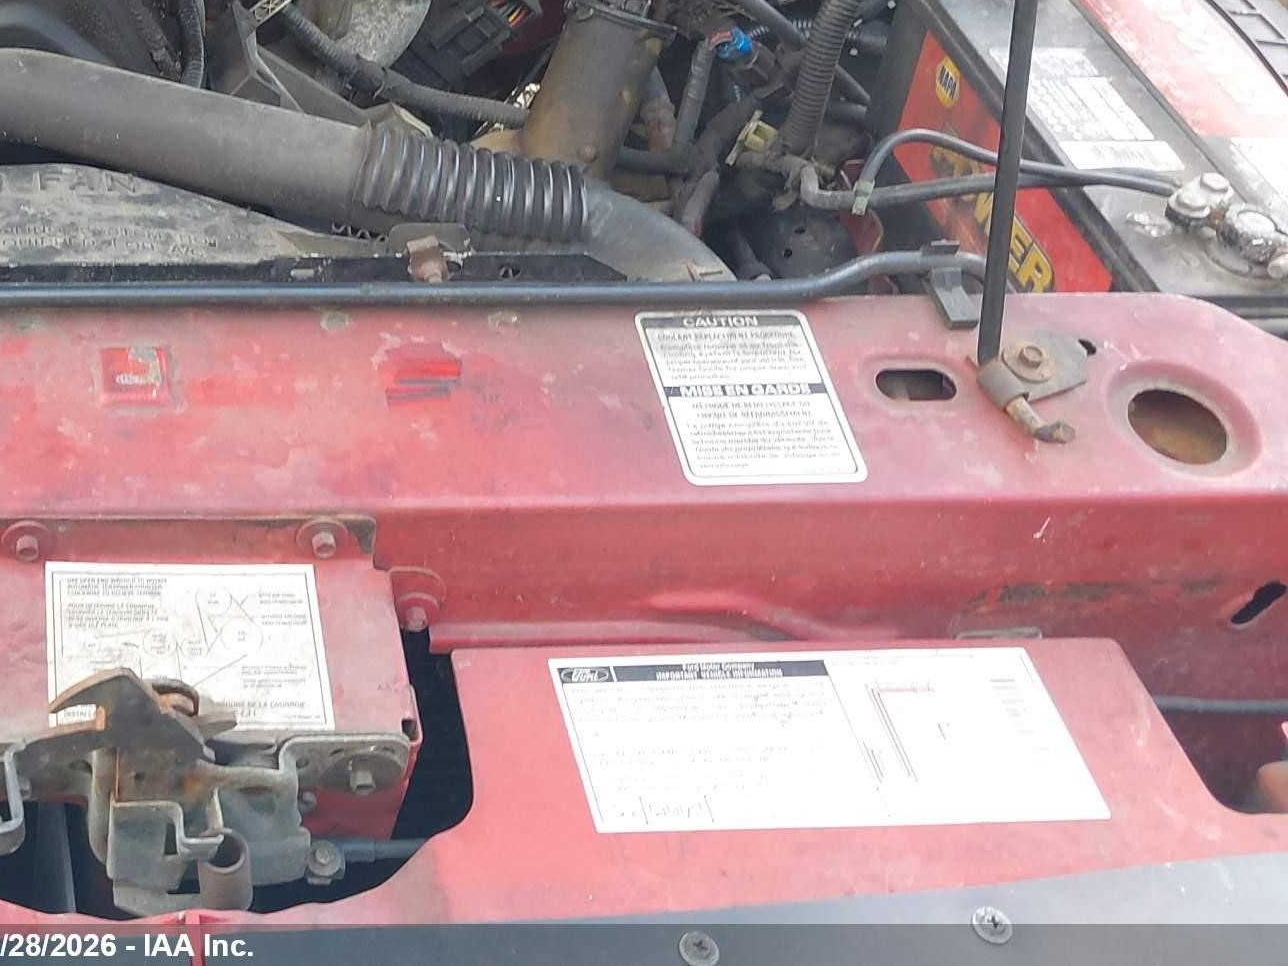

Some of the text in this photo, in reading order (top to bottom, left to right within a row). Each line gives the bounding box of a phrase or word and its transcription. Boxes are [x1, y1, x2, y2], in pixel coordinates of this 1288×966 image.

[939, 66, 957, 100] NAPA
[38, 169, 136, 194] FAN
[682, 315, 759, 328] CAUTION
[680, 383, 811, 397] MISE EN GARDE
[656, 668, 784, 681] IMPORTANT VEHICLE INFORMATION
[682, 663, 700, 672] Ford
[571, 668, 600, 682] Ford
